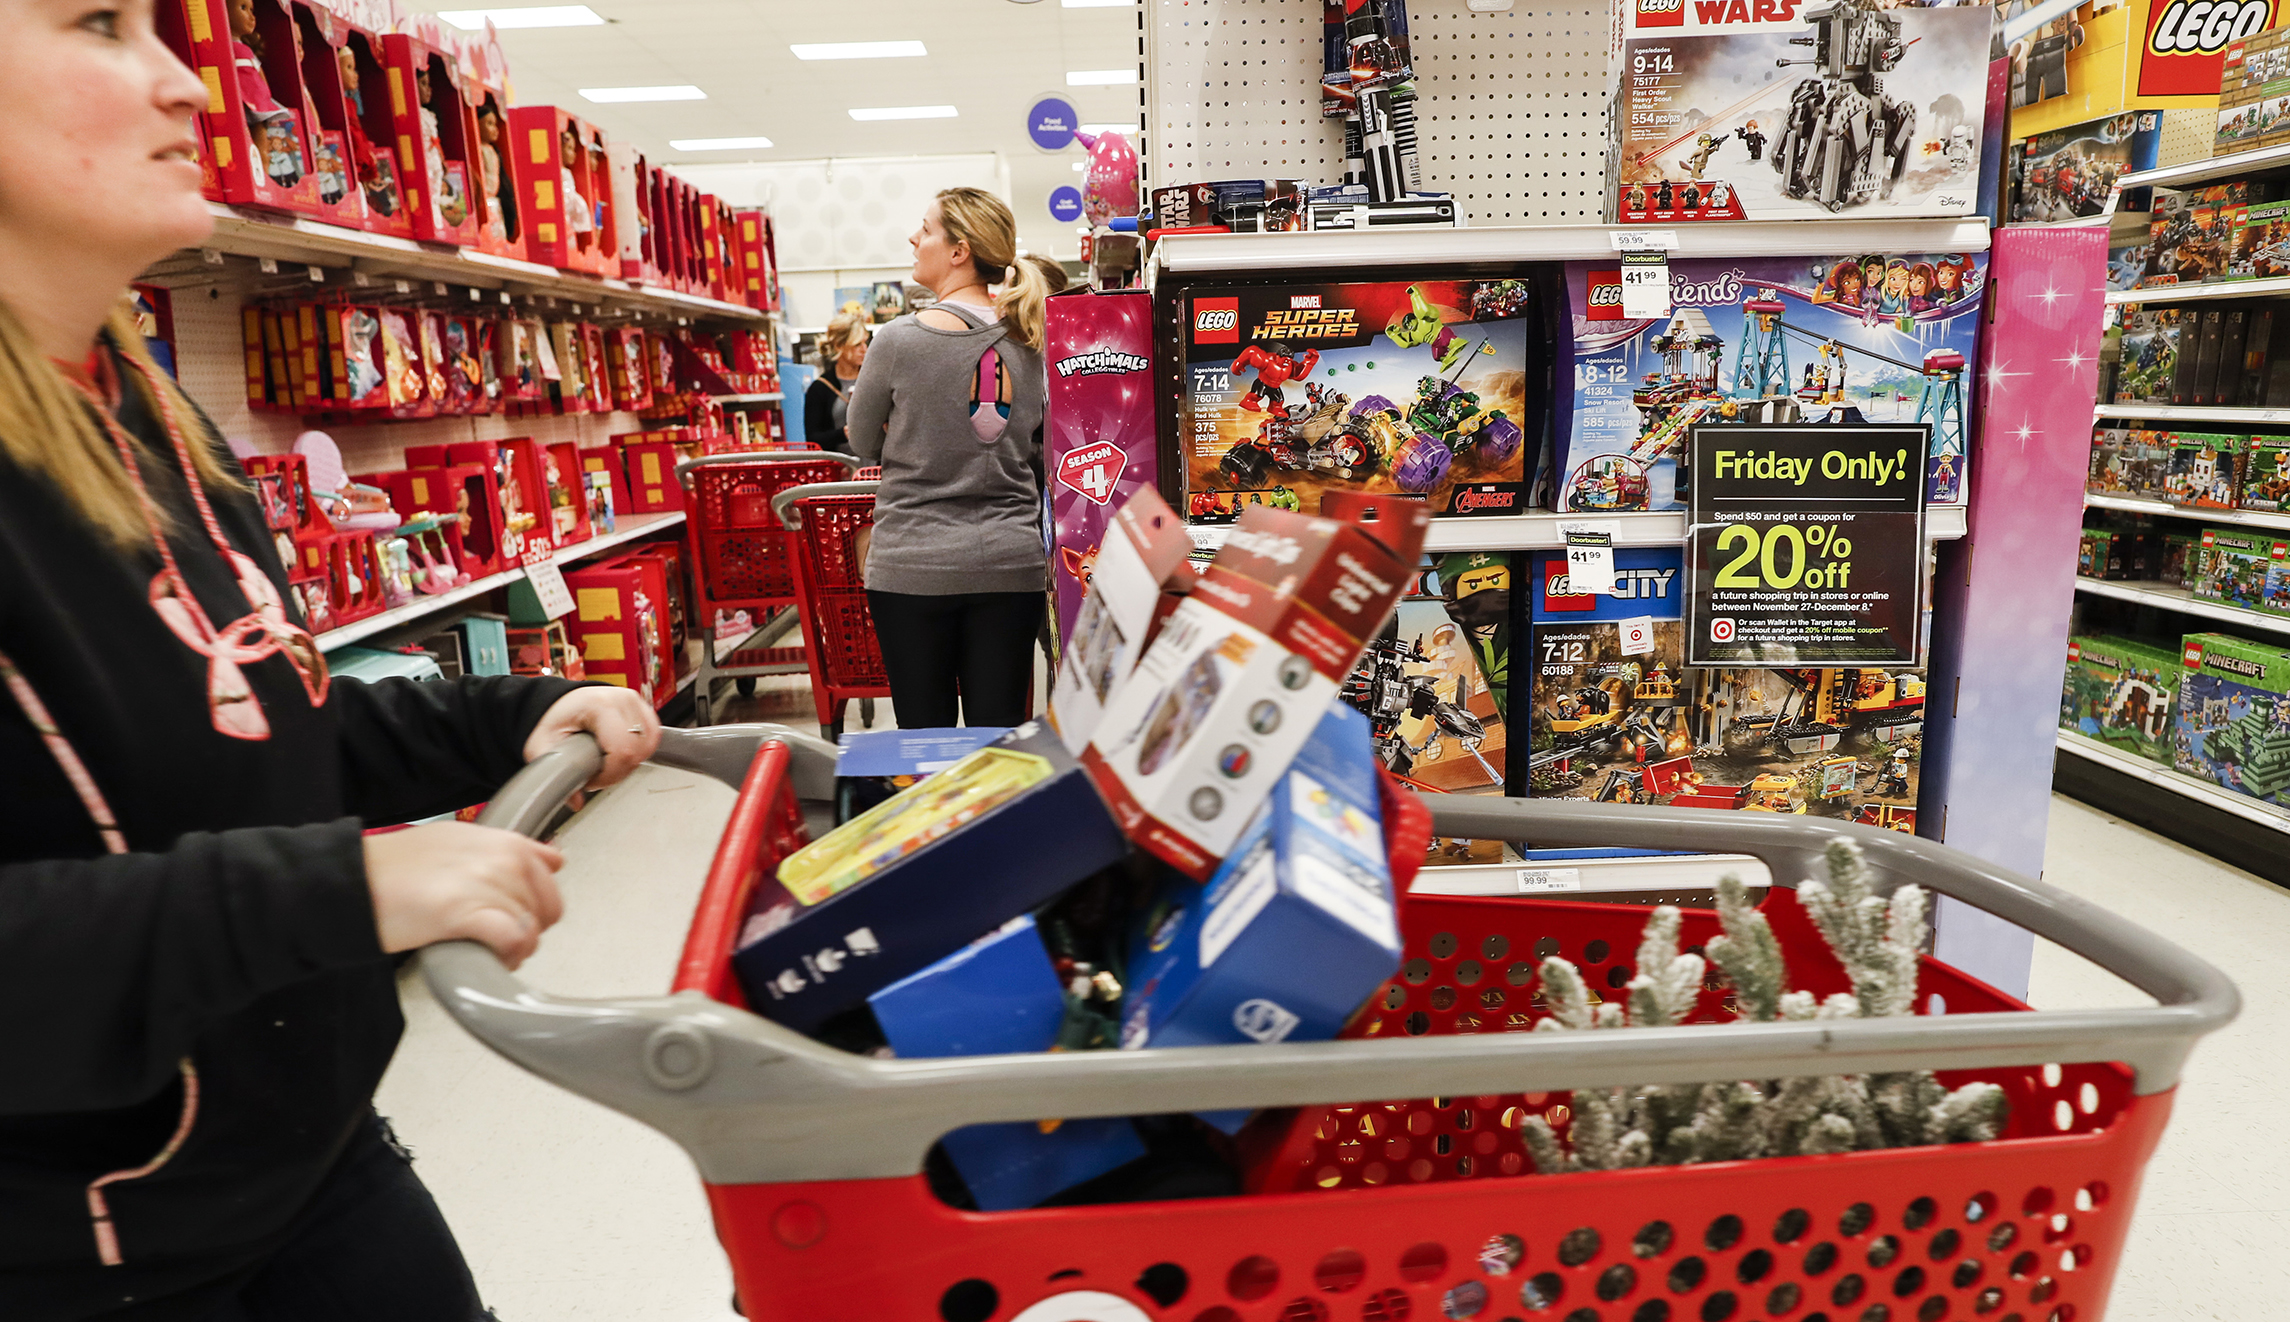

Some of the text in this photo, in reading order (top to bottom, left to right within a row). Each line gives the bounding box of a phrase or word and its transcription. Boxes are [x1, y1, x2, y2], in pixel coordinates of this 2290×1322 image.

[1694, 1, 1801, 25] WARS
[2154, 1, 2268, 50] LEGO
[1633, 47, 1671, 55] Ages/edades
[1633, 54, 1674, 74] 9-14
[1633, 77, 1661, 86] 75177
[1631, 112, 1681, 125] 554 pcs/pzs
[1938, 195, 1967, 208] Disney
[2248, 206, 2290, 220] MINECRAFT
[1618, 236, 1644, 245] 59.99
[1625, 255, 1664, 263] Doorbuster!
[1590, 285, 1623, 304] LEG
[1291, 295, 1322, 309] MARVEL
[1197, 310, 1237, 330] LEGO
[1265, 309, 1356, 325] SUPER
[1251, 323, 1360, 340] HEROES
[1585, 357, 1624, 365] Ages/edades
[1194, 367, 1229, 375] Ages/edades
[1584, 365, 1629, 384] 8-12
[1194, 374, 1230, 391] 7-14
[1584, 386, 1613, 396] 41324
[1194, 394, 1222, 403] 76078
[1195, 422, 1217, 432] 375
[1583, 417, 1633, 429] 585 pcs/pzs
[1195, 432, 1220, 443] pcs/pzs
[1066, 446, 1112, 469] SEASON
[1715, 448, 1907, 487] Friday Only!
[1082, 464, 1107, 498] 4
[1455, 487, 1516, 513] AVENGERS
[1714, 512, 1744, 523] Spend
[1745, 511, 1762, 521] $50
[1763, 512, 1781, 521] and
[1782, 513, 1798, 523] get
[1807, 514, 1841, 523] coupon
[1842, 512, 1856, 521] for
[1714, 523, 1852, 590] 20%
[1804, 562, 1851, 590] off
[1711, 591, 1890, 602] a future shopping trip in stores or online
[1711, 602, 1751, 611] between
[1752, 602, 1799, 611] November
[1800, 602, 1861, 611] 27-December
[1738, 618, 1748, 626] Or
[1767, 618, 1789, 626] Wallet
[1789, 618, 1797, 626] in
[1797, 618, 1810, 626] the
[1810, 619, 1833, 627] Target
[1542, 633, 1591, 642] Ages/edades
[1776, 635, 1810, 643] shopping
[1542, 642, 1584, 662] 7-12
[2185, 649, 2201, 661] LEGO
[2081, 650, 2122, 669] MINECRAFT
[2204, 652, 2267, 679] MINECRAFT
[1542, 666, 1574, 676] 60188
[2182, 673, 2191, 684] 8+
[1523, 876, 1548, 885] 99.99
